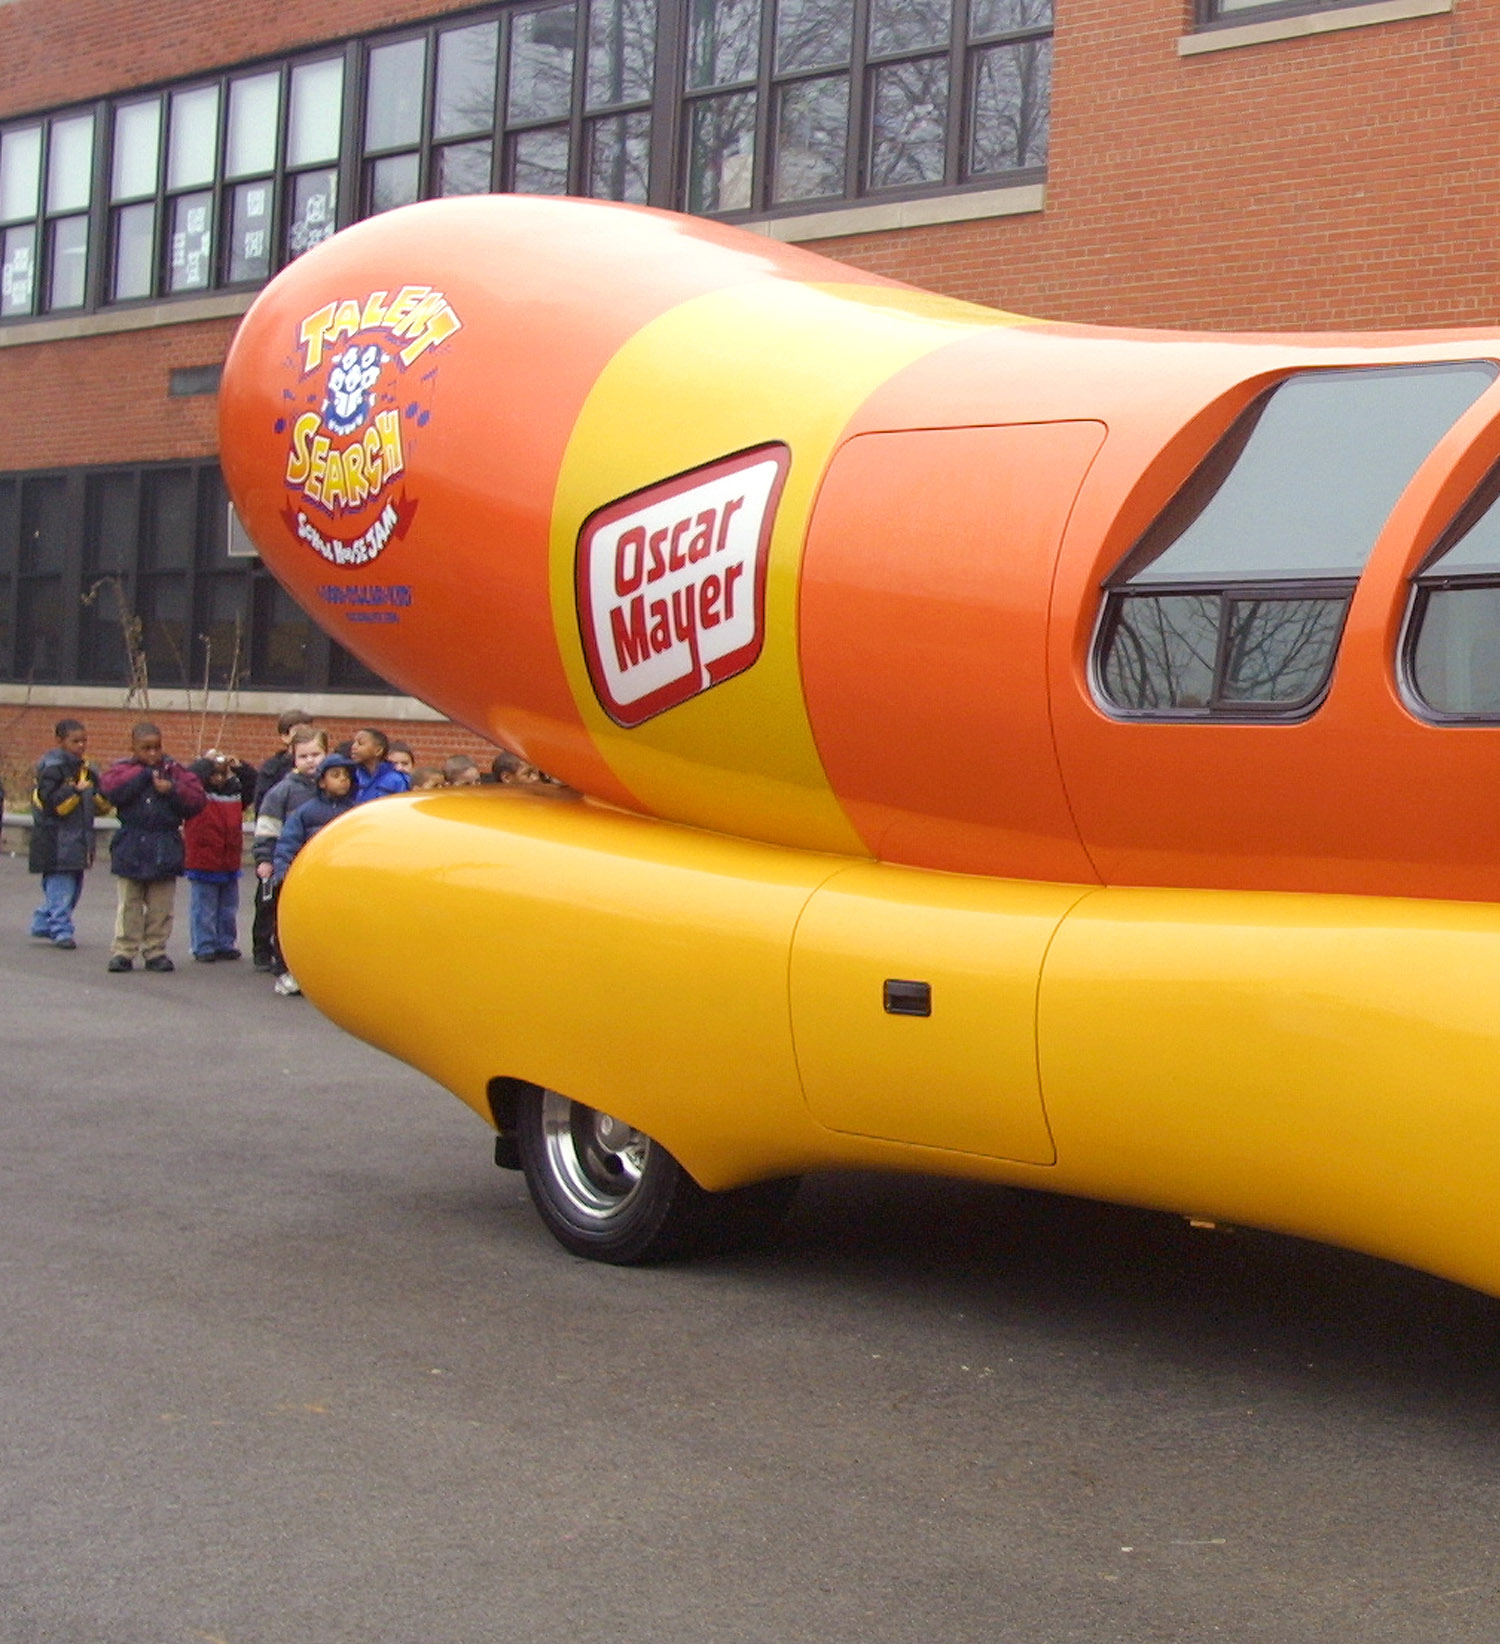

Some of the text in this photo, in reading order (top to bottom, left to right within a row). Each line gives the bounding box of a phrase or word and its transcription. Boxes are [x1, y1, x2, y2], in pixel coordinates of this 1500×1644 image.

[301, 285, 463, 373] TALENT
[285, 408, 405, 511] SEARCH
[365, 501, 399, 559] JAM
[614, 494, 746, 599] Oscar
[608, 561, 745, 676] Mayer
